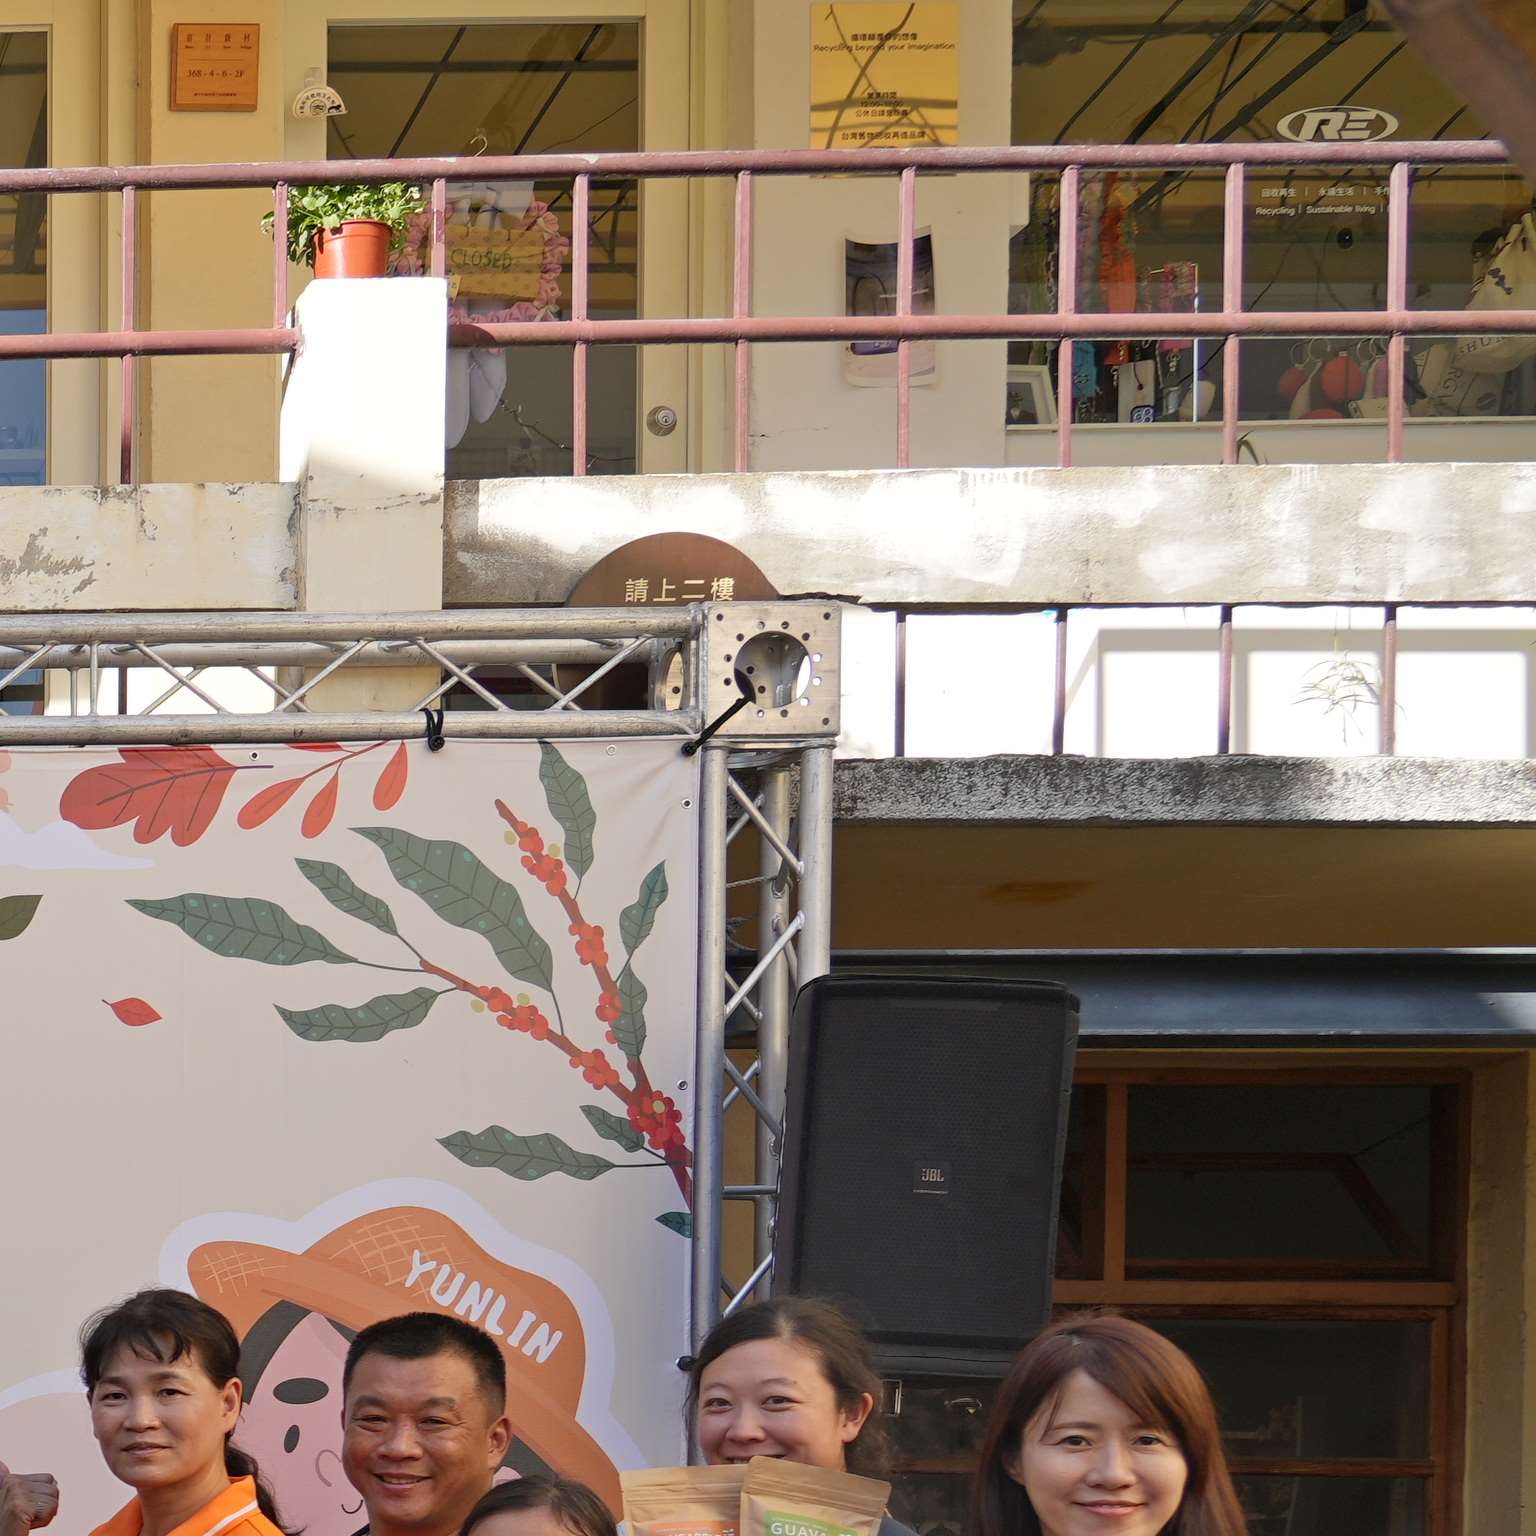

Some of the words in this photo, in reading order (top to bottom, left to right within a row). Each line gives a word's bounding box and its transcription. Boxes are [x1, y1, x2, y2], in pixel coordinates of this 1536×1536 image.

[1255, 206, 1297, 217] Recycling
[1306, 204, 1353, 215] Sustainable
[624, 576, 736, 602] 請上二樓
[921, 1167, 945, 1182] JBL
[403, 1249, 564, 1365] YUNLIN
